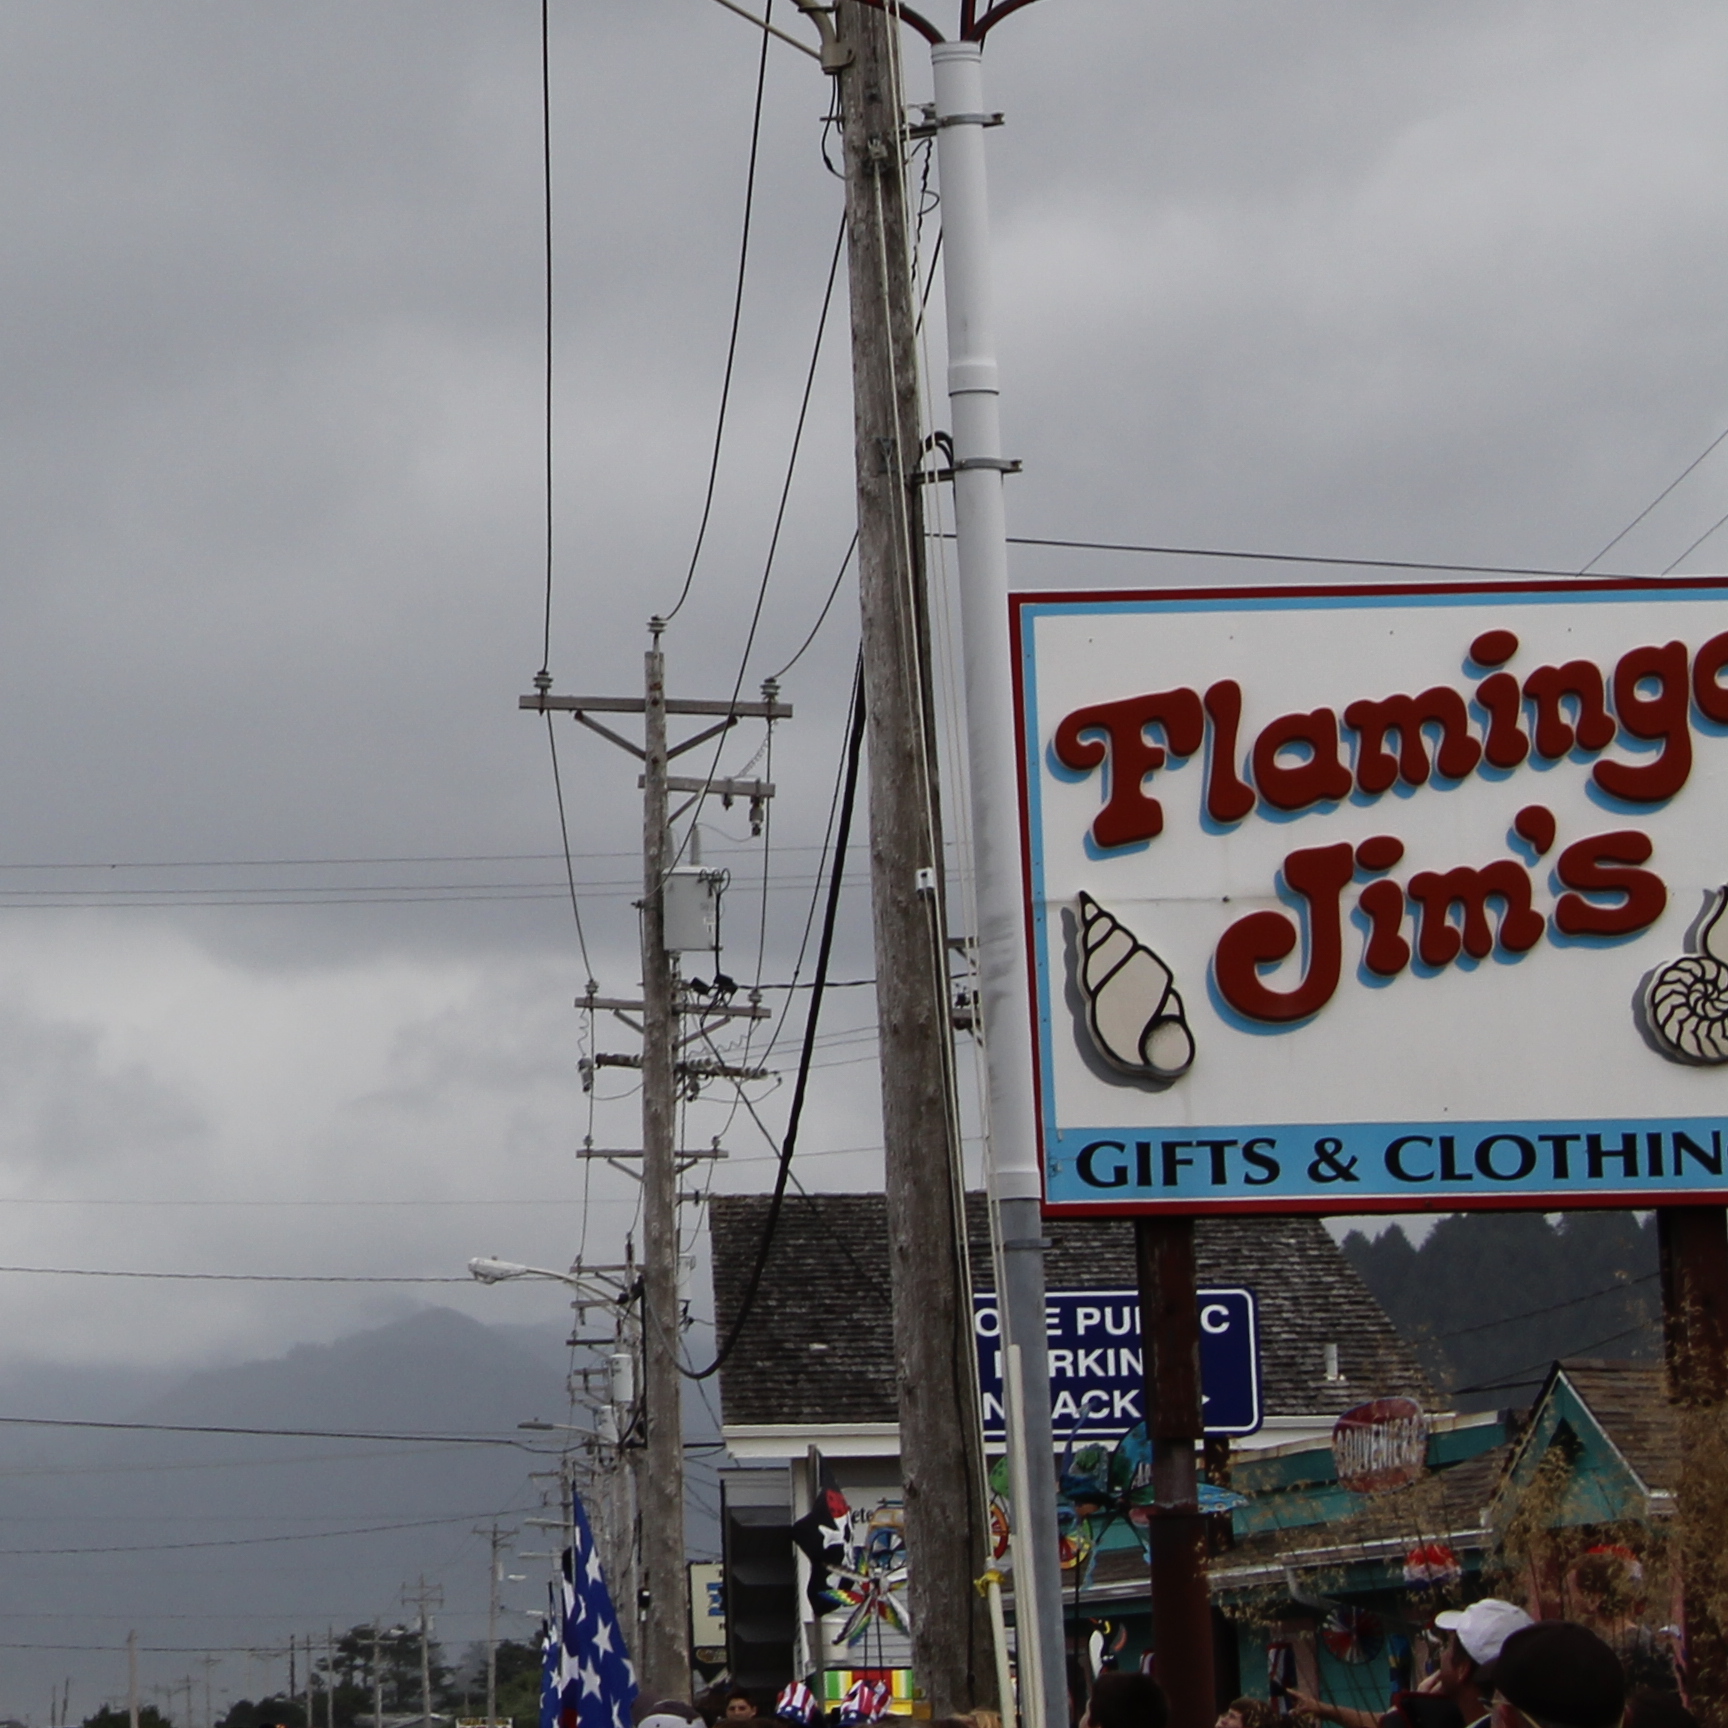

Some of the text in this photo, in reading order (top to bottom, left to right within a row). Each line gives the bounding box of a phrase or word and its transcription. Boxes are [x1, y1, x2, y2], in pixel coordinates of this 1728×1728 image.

[1215, 804, 1667, 1024] Jim's
[1075, 1130, 1728, 1188] GIFTS & CLOTHIN
[974, 1304, 1231, 1337] OE PUC
[994, 1347, 1144, 1379] RKIN
[1051, 1389, 1142, 1420] ACK
